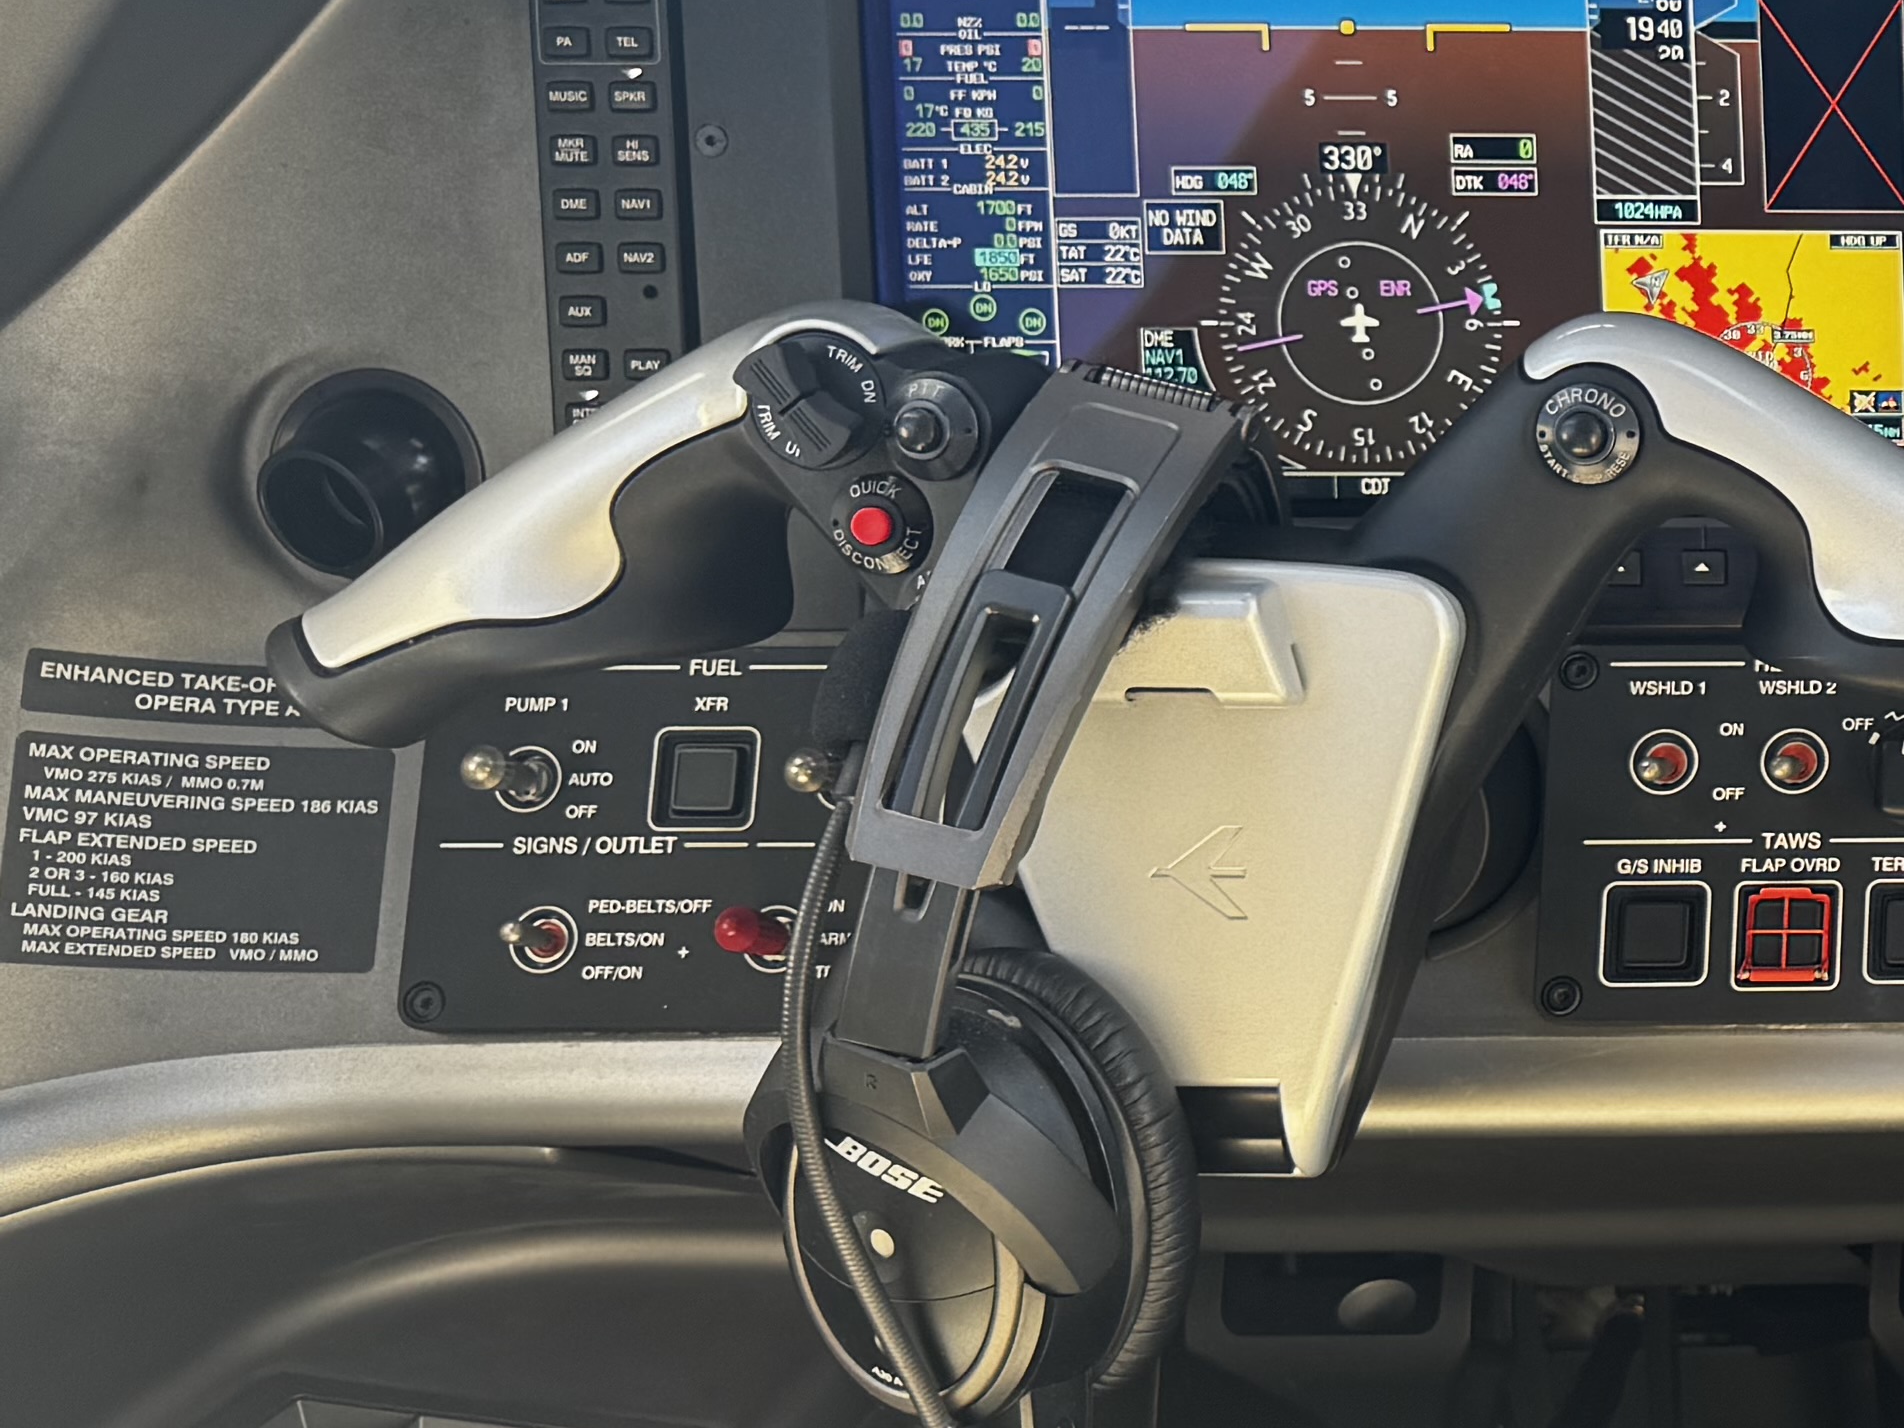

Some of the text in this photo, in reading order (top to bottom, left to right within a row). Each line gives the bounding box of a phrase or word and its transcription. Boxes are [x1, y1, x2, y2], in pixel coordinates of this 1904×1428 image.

[548, 90, 588, 102] MUSIC
[40, 661, 175, 688] ENHANCED
[689, 658, 743, 677] FUEL
[1629, 680, 1706, 696] WSHLD 1
[504, 696, 569, 713] PUMP 1
[694, 696, 729, 712] XFR
[28, 742, 271, 771] MAX OPERATING SPEED
[24, 784, 379, 814] MAX MANEUVERING SPEED 186 KIAS
[22, 805, 152, 829] VMC 97 KIAS
[19, 827, 258, 854] FLAP EXTENDED SPEED
[512, 835, 679, 856] SIGNS / OUTLET
[1761, 831, 1822, 850] TAWS
[1740, 857, 1841, 873] FLAP OVRD
[10, 901, 169, 924] LANDING GEAR
[584, 932, 665, 948] BELTS/ON
[822, 1136, 946, 1205] BOSE
